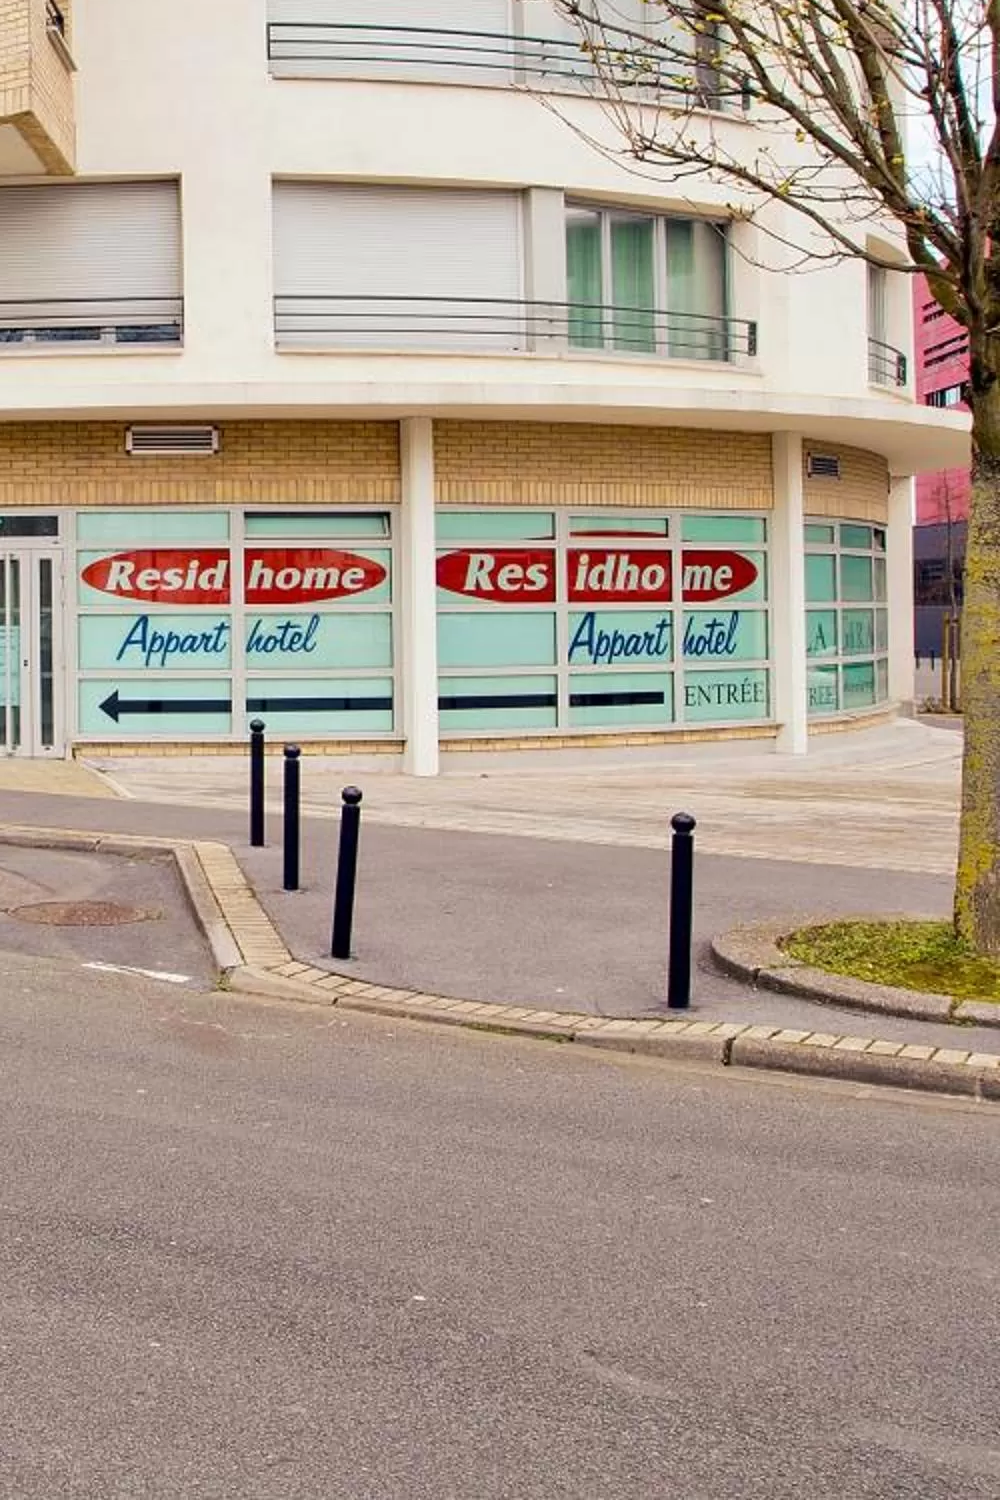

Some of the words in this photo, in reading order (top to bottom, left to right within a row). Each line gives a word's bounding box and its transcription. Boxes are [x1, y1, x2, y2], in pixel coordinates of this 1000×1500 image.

[116, 614, 231, 667] Appart
[246, 614, 320, 653] hotel
[568, 611, 673, 665] Appart
[683, 611, 739, 656] hotel
[684, 677, 764, 707] ENTRÉE
